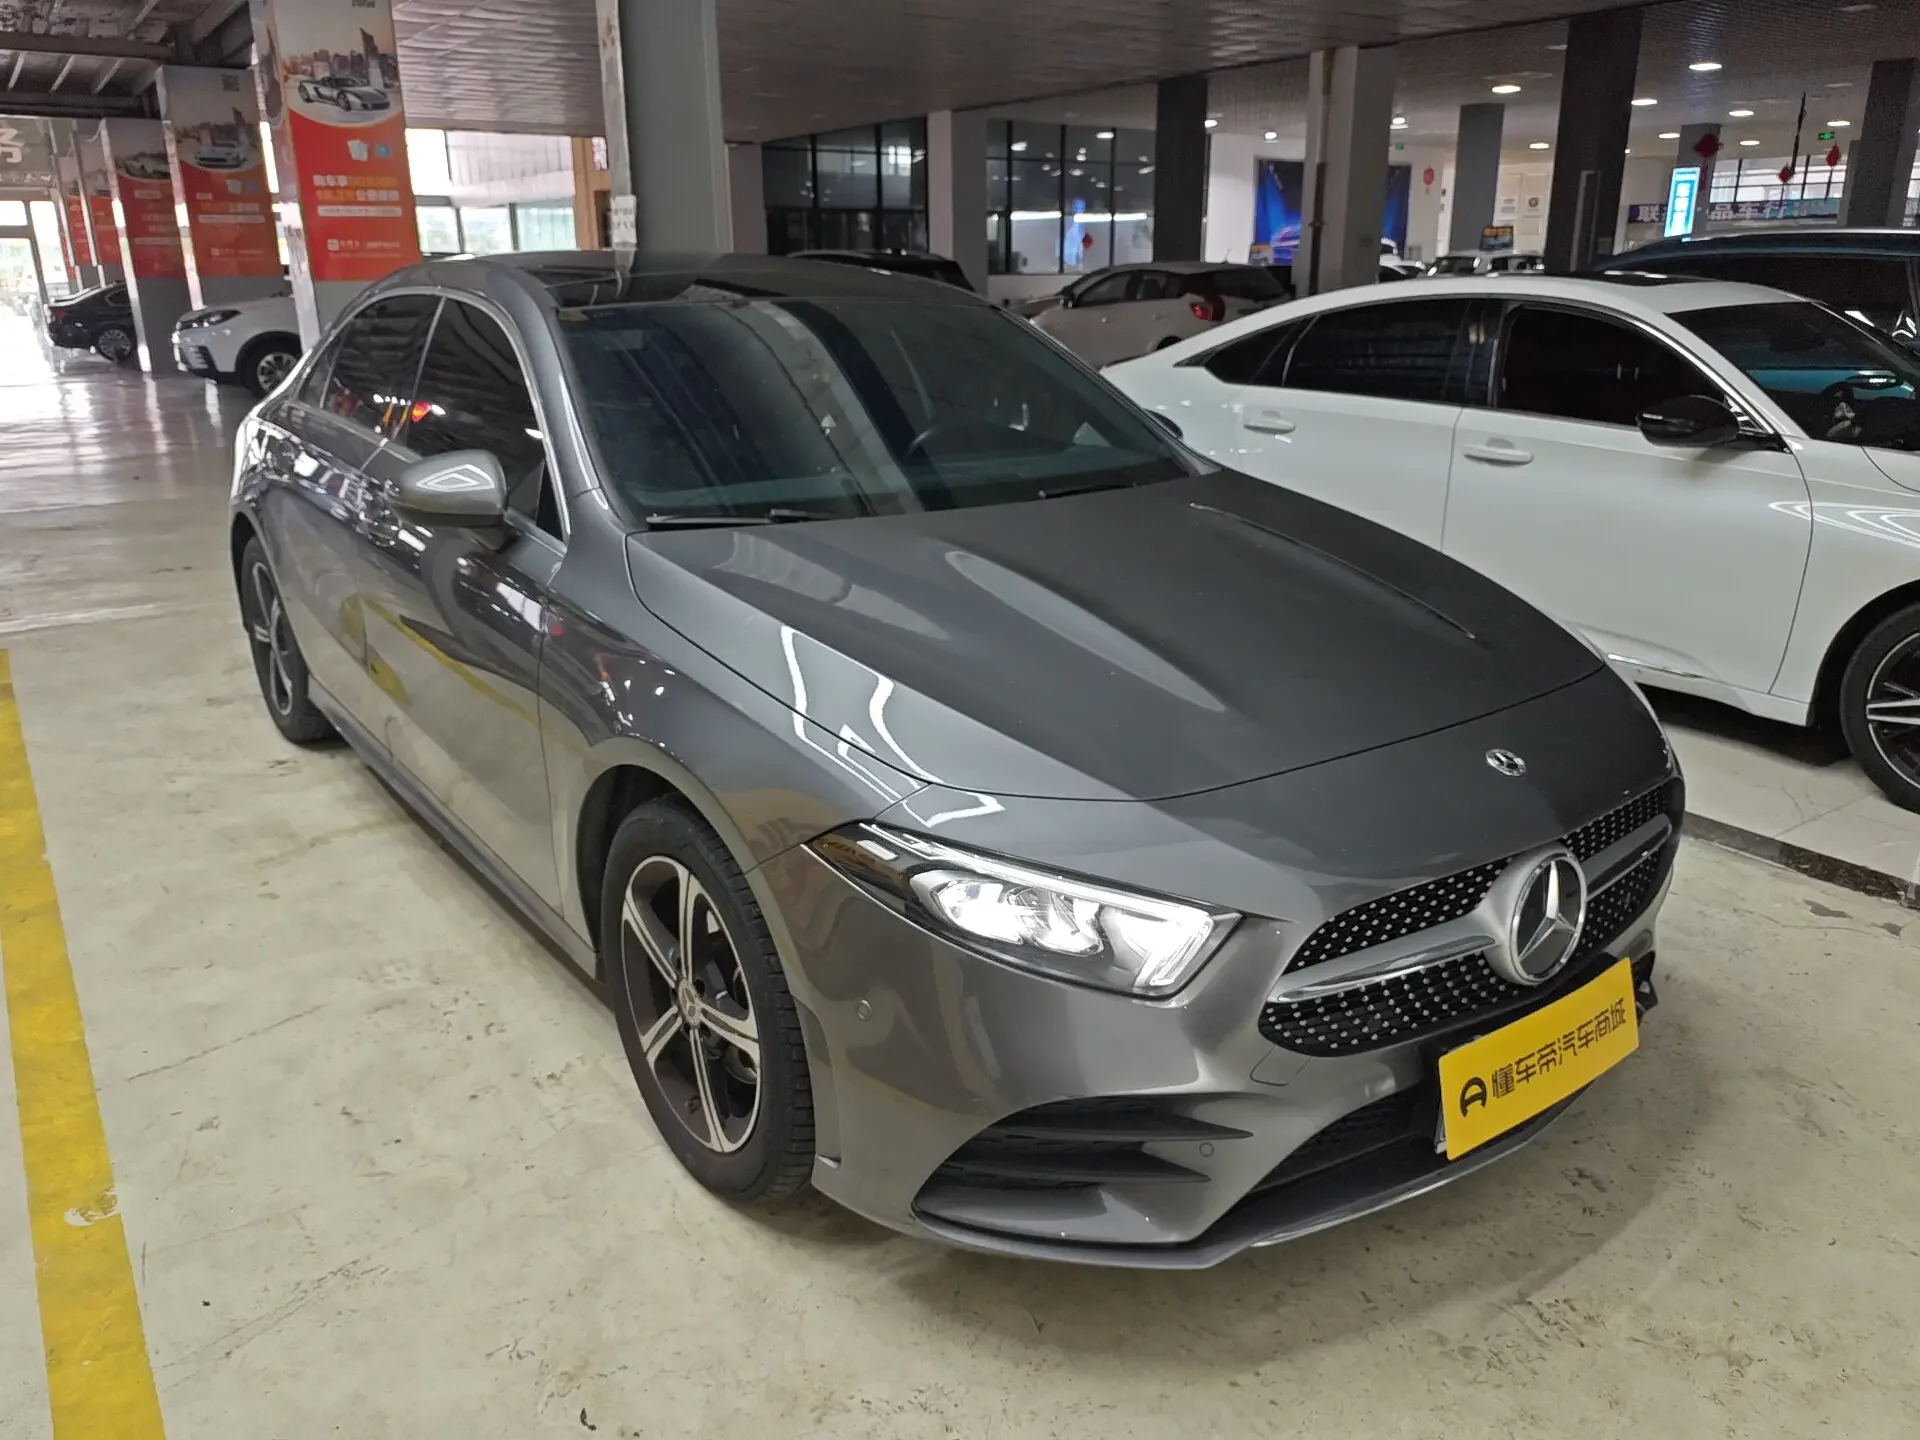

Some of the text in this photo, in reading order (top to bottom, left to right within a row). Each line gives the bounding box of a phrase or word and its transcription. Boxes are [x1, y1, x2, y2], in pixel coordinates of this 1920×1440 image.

[1491, 998, 1626, 1099] 懂车帝汽车商城
